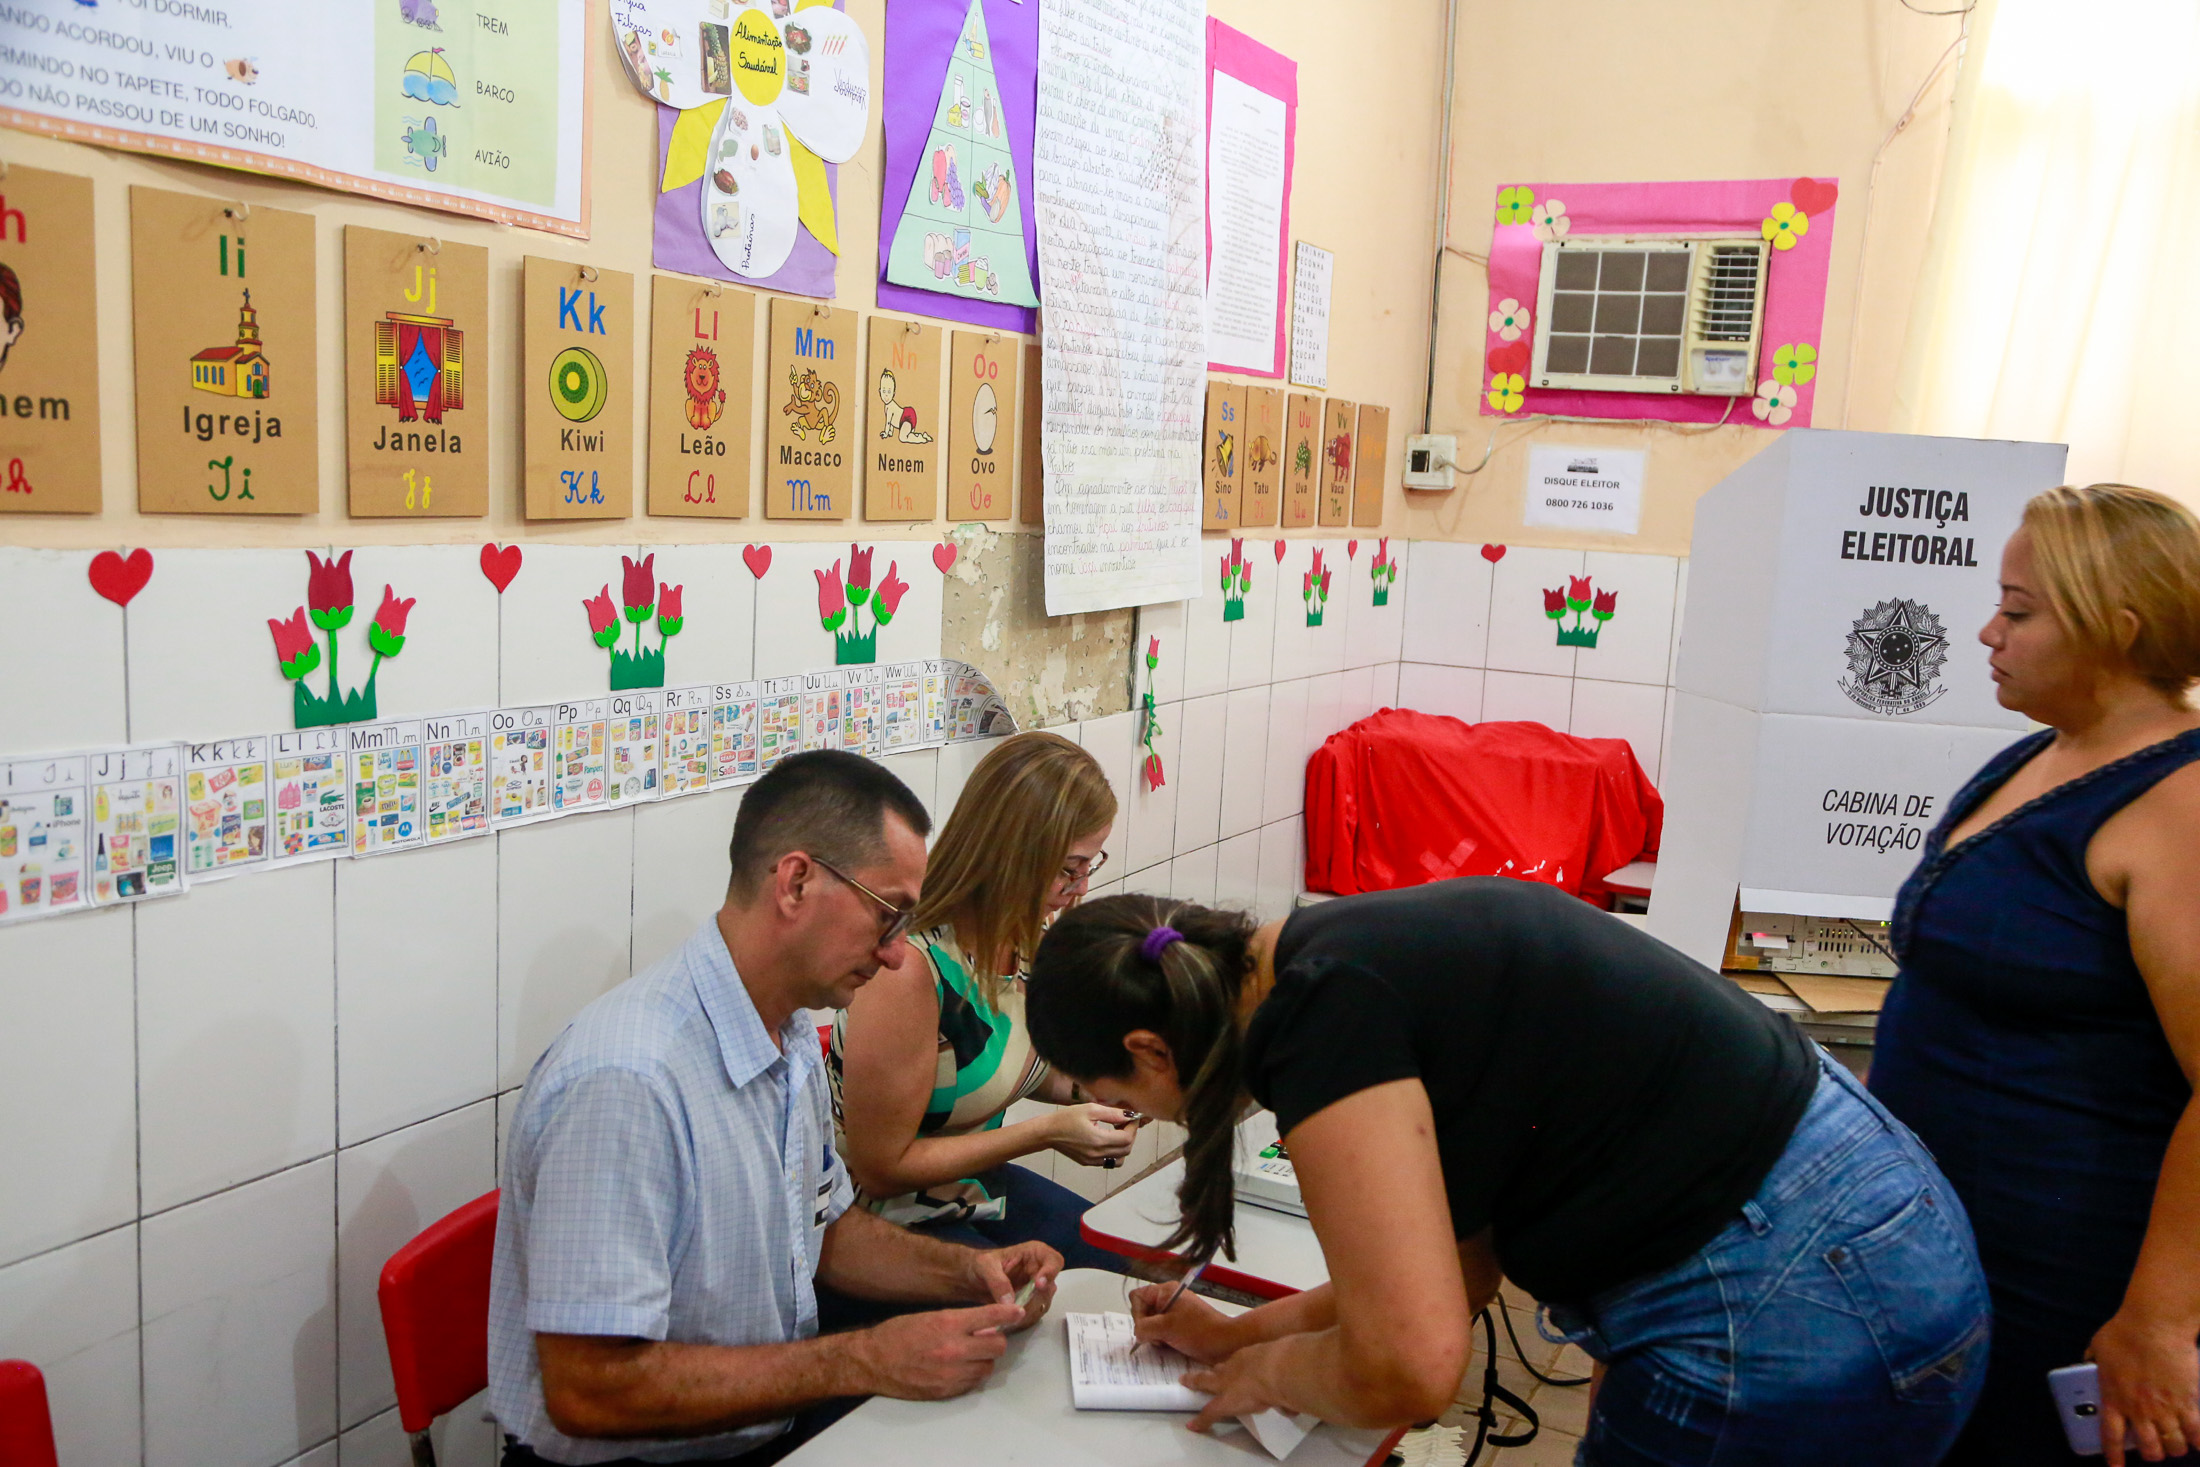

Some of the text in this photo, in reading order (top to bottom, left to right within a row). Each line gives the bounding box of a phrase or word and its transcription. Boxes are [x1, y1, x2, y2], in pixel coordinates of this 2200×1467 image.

[155, 0, 232, 29] DORMIR.
[476, 13, 509, 36] TREM
[56, 20, 159, 59] ACORDOU,
[165, 43, 194, 64] VIU
[200, 52, 214, 68] O
[735, 21, 782, 50] Alimentação
[738, 51, 778, 75] Saudável
[80, 64, 109, 85] NO
[115, 71, 189, 102] TAPETE,
[194, 87, 244, 111] TODO
[249, 98, 318, 130] FOLGADO.
[476, 80, 515, 103] BARCO
[29, 83, 71, 108] NÃO
[76, 93, 153, 123] PASSOU
[161, 110, 184, 129] DE
[190, 115, 218, 134] UM
[224, 122, 285, 148] SONHO!
[475, 149, 510, 169] AVIÃO
[404, 266, 436, 314] Jj
[559, 286, 606, 335] Kk
[695, 307, 718, 341] Ll
[795, 327, 834, 360] Mm
[892, 343, 917, 371] Nn
[973, 353, 998, 380] Oo
[0, 394, 70, 421] em
[1221, 401, 1235, 422] Ss
[183, 405, 282, 444] Igreja
[1299, 410, 1311, 428] Uu
[1337, 412, 1348, 430] Vv
[373, 425, 462, 453] Janela
[560, 428, 604, 452] Kiwi
[680, 433, 726, 457] Leão
[780, 445, 842, 467] Macaco
[878, 453, 924, 473] Nenem
[971, 457, 995, 475] Ovo
[560, 470, 605, 504] Kk
[684, 469, 716, 504] Ll
[1215, 480, 1232, 495] Sino
[1254, 481, 1269, 495] Tatu
[1295, 482, 1308, 494] Uva
[1330, 482, 1345, 495] Vaca
[1544, 477, 1620, 489] DISQUE ELEITOR
[786, 479, 832, 512] Mm
[886, 481, 913, 511] Nn
[970, 483, 992, 511] Oo
[1545, 498, 1614, 511] 0800 726 1036
[1860, 486, 1969, 528] JUSTIÇA
[1841, 530, 1978, 567] ELEITORAL
[848, 671, 861, 684] Vv
[885, 666, 902, 678] Ww
[924, 662, 938, 674] Xx
[764, 681, 777, 694] Tt
[807, 675, 820, 689] Uu
[667, 692, 681, 707] Rr
[715, 686, 731, 700] Ss
[559, 705, 577, 722] Pp
[613, 698, 631, 716] Qq
[427, 722, 449, 740] Nn
[493, 714, 514, 730] Oo
[279, 735, 290, 752] L
[352, 731, 382, 750] Mm
[191, 745, 206, 763] K
[213, 744, 223, 761] k
[584, 765, 604, 775] Pampers
[719, 766, 736, 776] Sadia
[320, 804, 345, 812] LACOSTE
[1822, 789, 1934, 818] CABINA DE
[1826, 822, 1922, 853] VOTAÇÃO
[152, 864, 173, 873] Jeep
